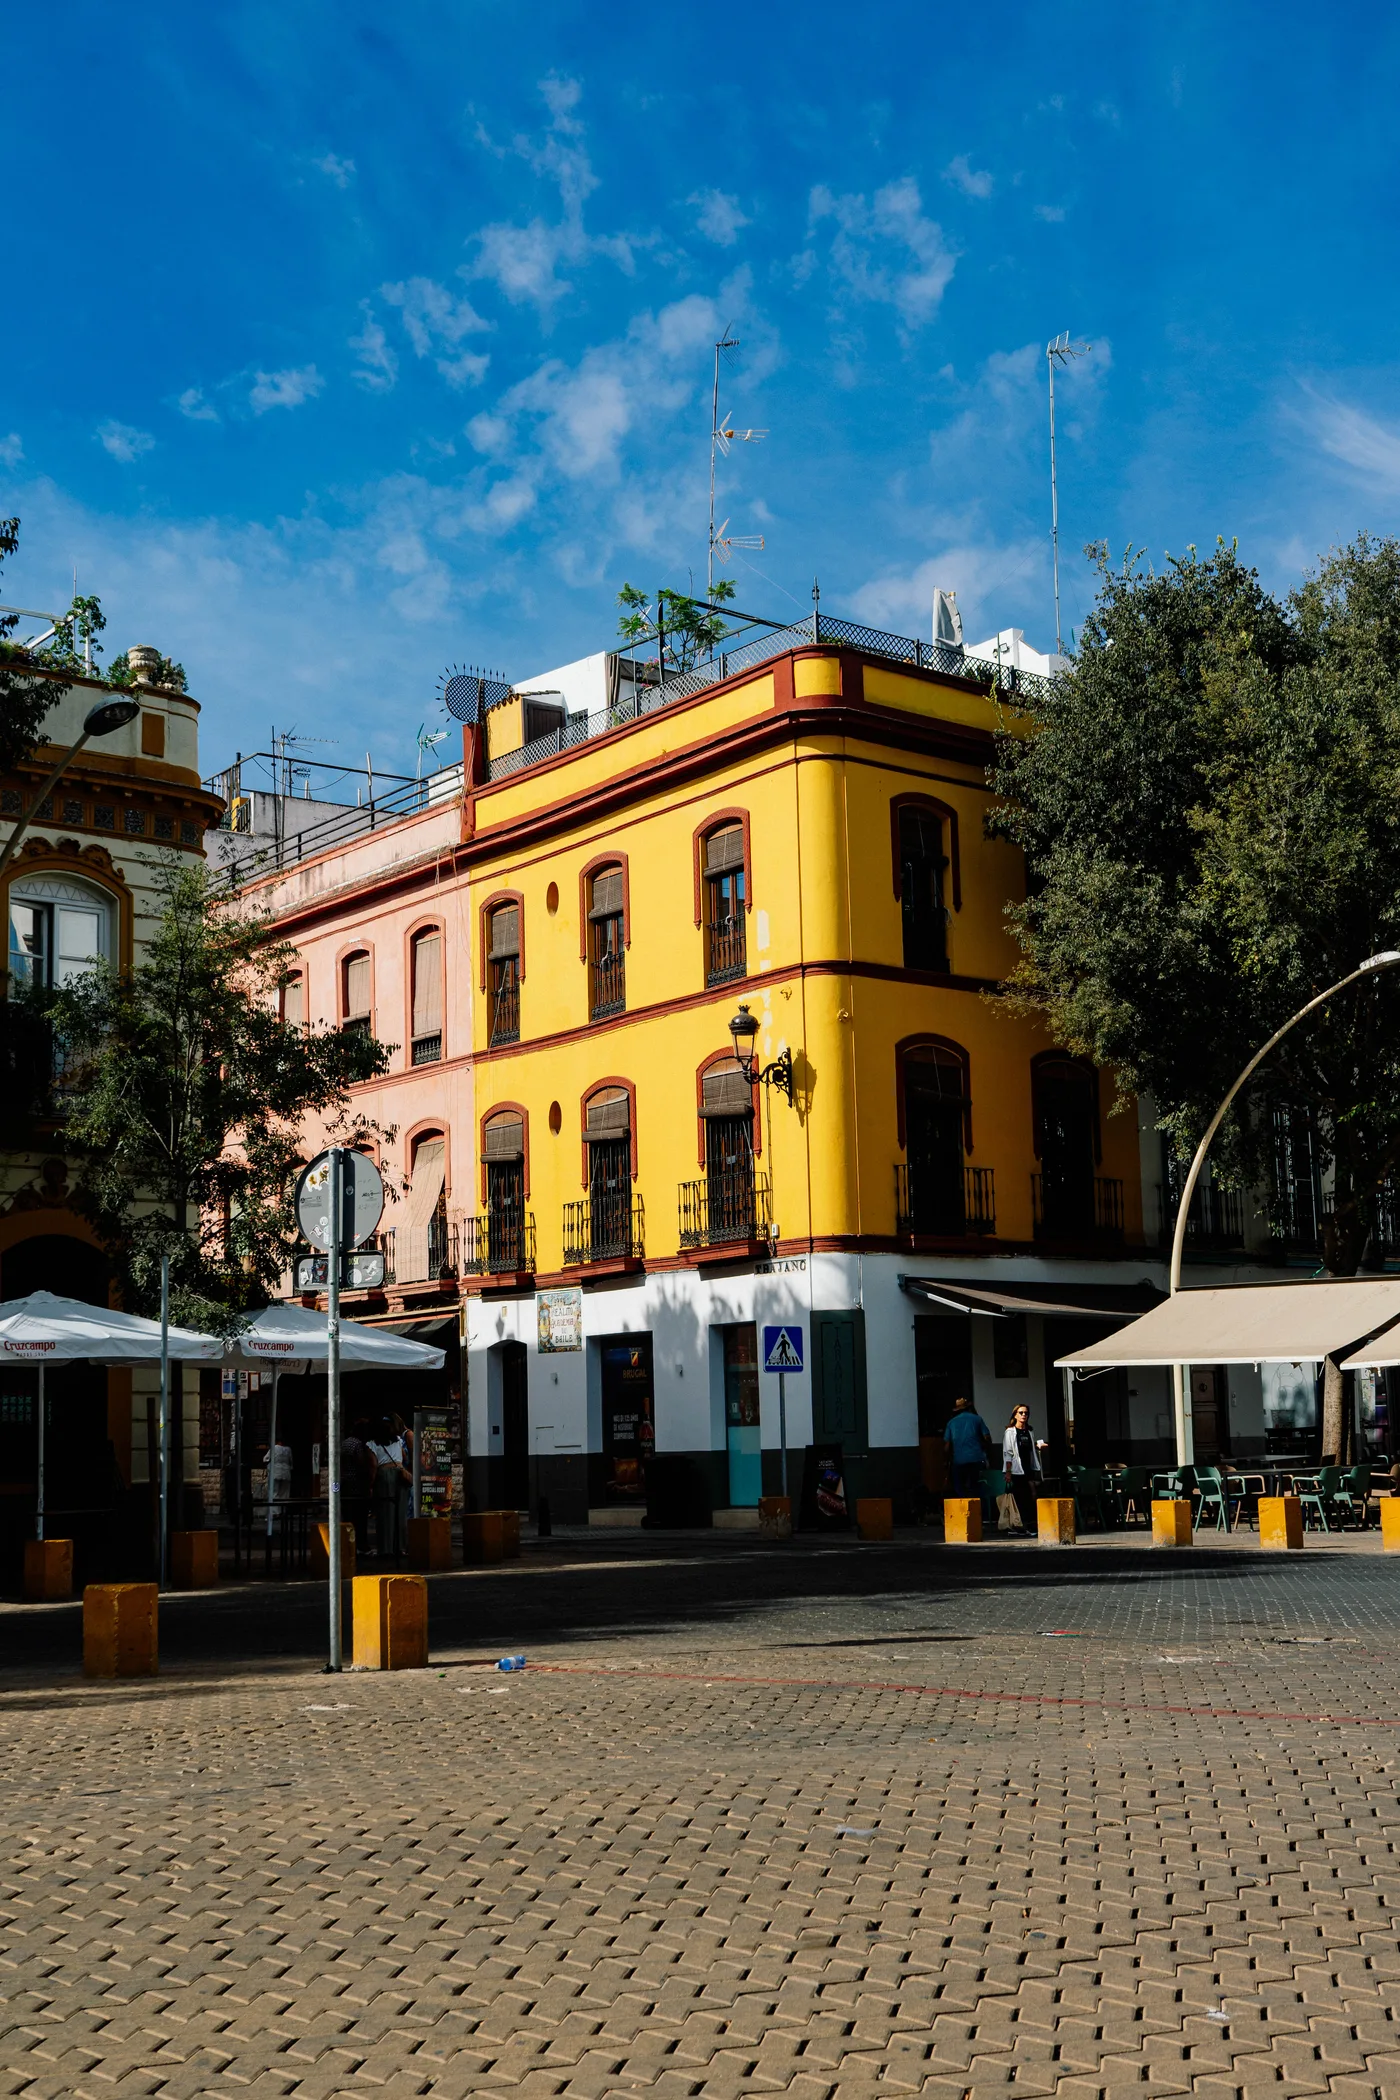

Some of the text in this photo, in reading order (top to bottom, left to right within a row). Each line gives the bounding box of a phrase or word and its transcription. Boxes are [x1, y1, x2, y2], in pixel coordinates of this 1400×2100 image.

[755, 1259, 806, 1274] TRAJANO
[555, 1334, 572, 1344] BAILE
[4, 1340, 56, 1352] Cruzcampo
[248, 1340, 294, 1352] Cruzcampo
[622, 1368, 648, 1379] BRUGAL
